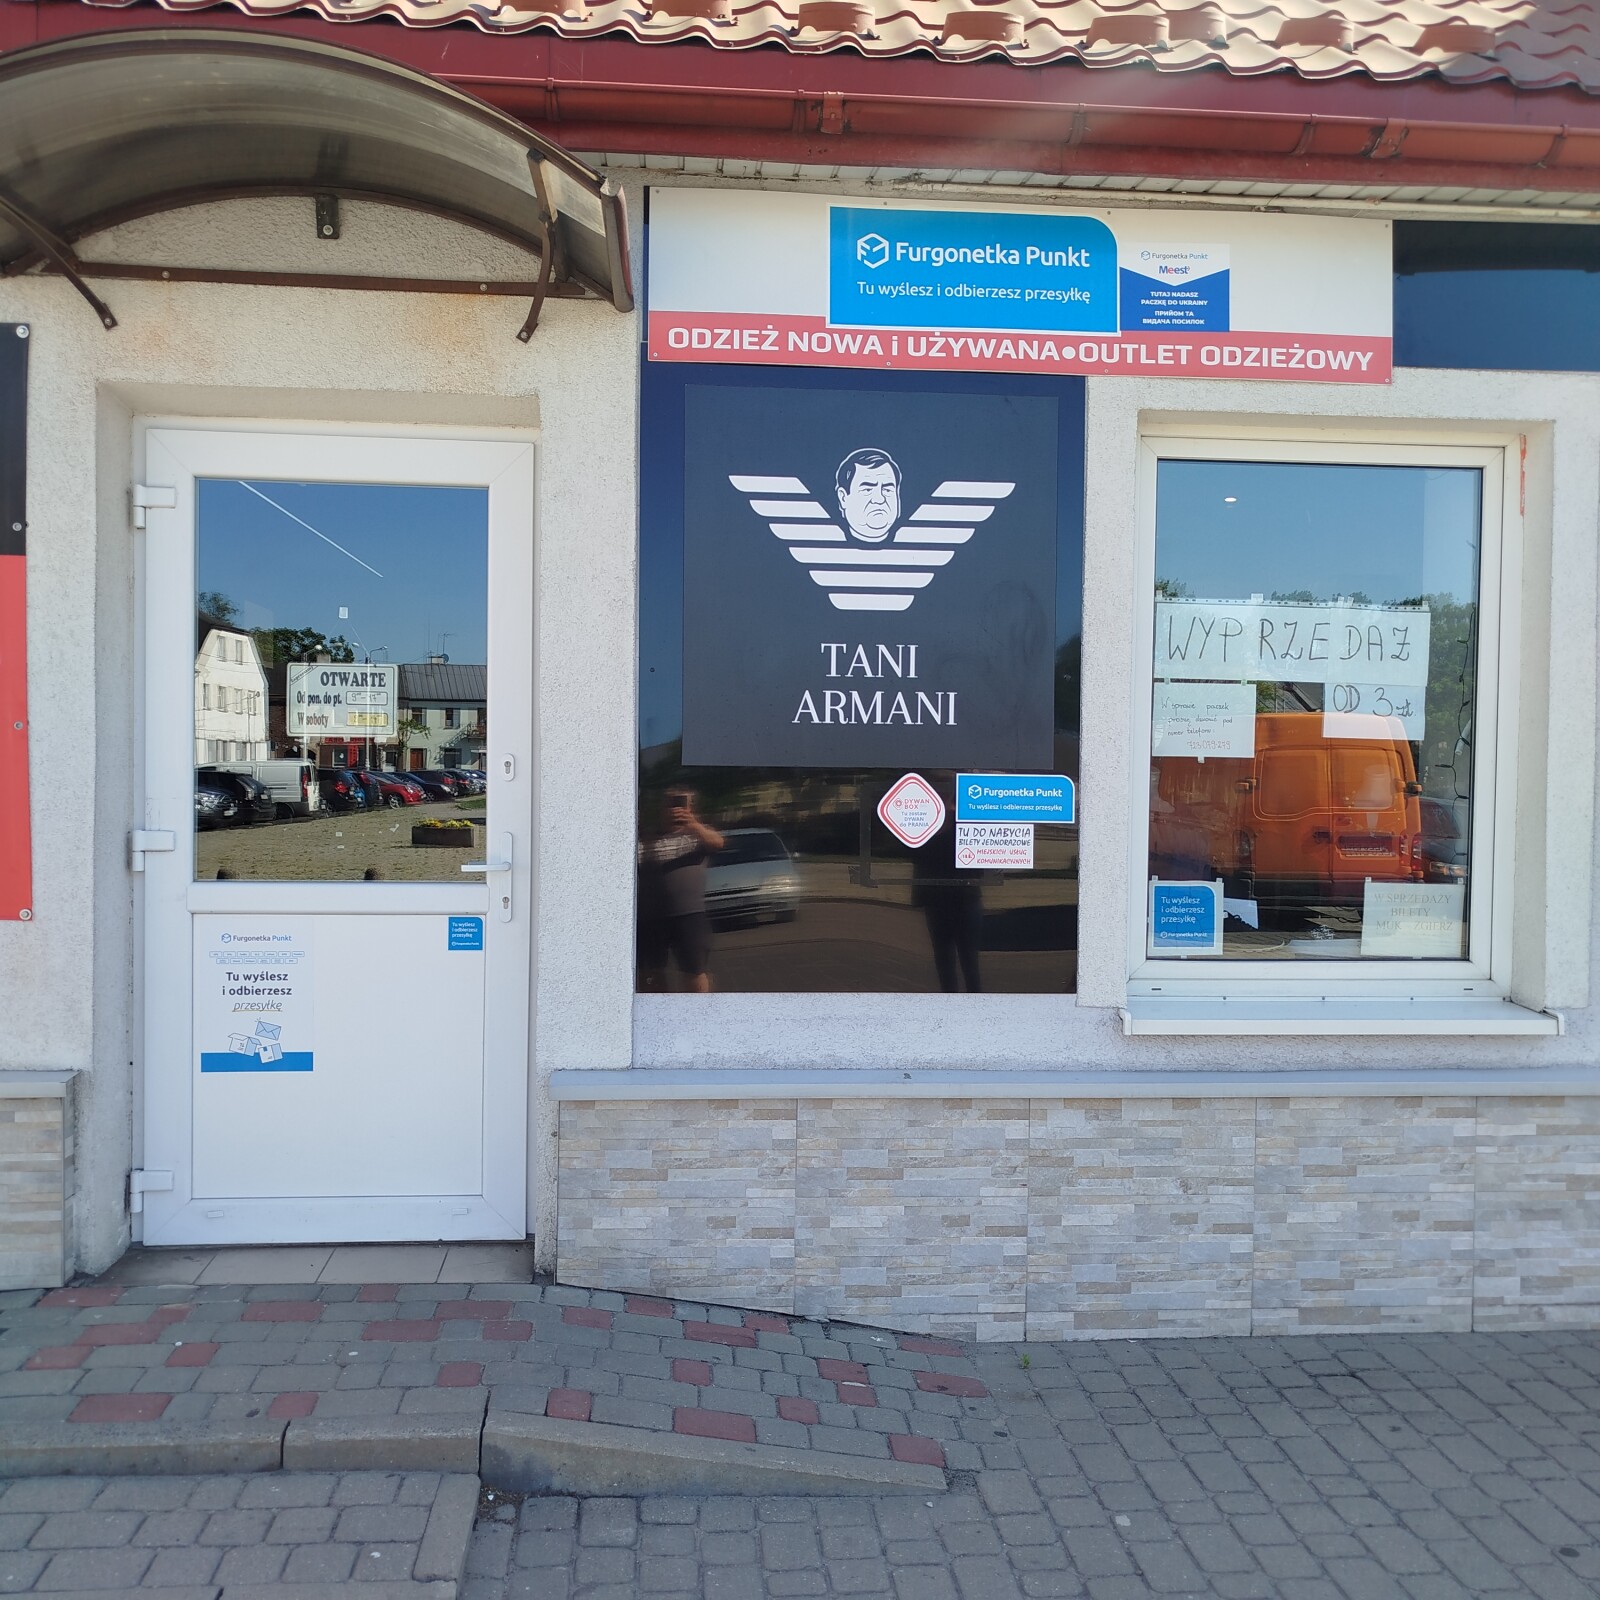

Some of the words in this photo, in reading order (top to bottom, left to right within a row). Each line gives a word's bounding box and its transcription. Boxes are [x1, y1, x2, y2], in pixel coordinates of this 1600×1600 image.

[896, 241, 1020, 267] Furgonetka
[1026, 245, 1091, 267] Punkt
[1159, 266, 1190, 274] Meest
[857, 281, 876, 296] Tu
[878, 281, 934, 300] wyślesz
[937, 283, 942, 297] i
[944, 282, 1022, 299] odbierzesz
[1025, 285, 1091, 304] przesyłkę
[667, 324, 780, 353] ODZIEŻ
[787, 329, 884, 356] NOWA
[891, 335, 899, 356] i
[907, 331, 1061, 361] UŻYWANA
[1078, 342, 1193, 366] OUTLET
[1200, 343, 1374, 371] ODZIEŻOWY
[820, 642, 919, 679] TANI
[320, 671, 387, 688] OTWARTE
[297, 691, 305, 704] Od
[307, 693, 322, 706] pon.
[324, 692, 332, 704] do
[333, 693, 342, 706] pt.
[1332, 684, 1362, 714] OD
[1372, 686, 1394, 718] 3
[791, 689, 958, 726] ARMANI
[1206, 702, 1230, 715] paczek
[297, 712, 305, 725] W
[306, 713, 329, 728] soboty
[1222, 716, 1233, 728] pod
[983, 787, 1034, 798] Furgonetka
[1036, 788, 1062, 797] Punkt
[976, 803, 999, 811] wyślesz
[958, 827, 970, 838] TU
[973, 827, 987, 838] DO
[989, 827, 1031, 838] NABYCIA
[958, 838, 981, 846] BILETY
[981, 838, 1032, 847] JEDNORAZOWE
[1160, 896, 1171, 904] Tu
[1171, 895, 1201, 906] wyślesz
[1164, 905, 1206, 914] odbierzesz
[1391, 907, 1431, 917] BILETY
[1413, 920, 1454, 931] ZGIERZ
[232, 933, 271, 943] Furgonetka
[271, 934, 293, 943] Punkt
[225, 971, 240, 982] Tu
[242, 970, 289, 984] wyślesz
[228, 985, 293, 996] odbierzesz
[232, 999, 283, 1013] przesyłkę
